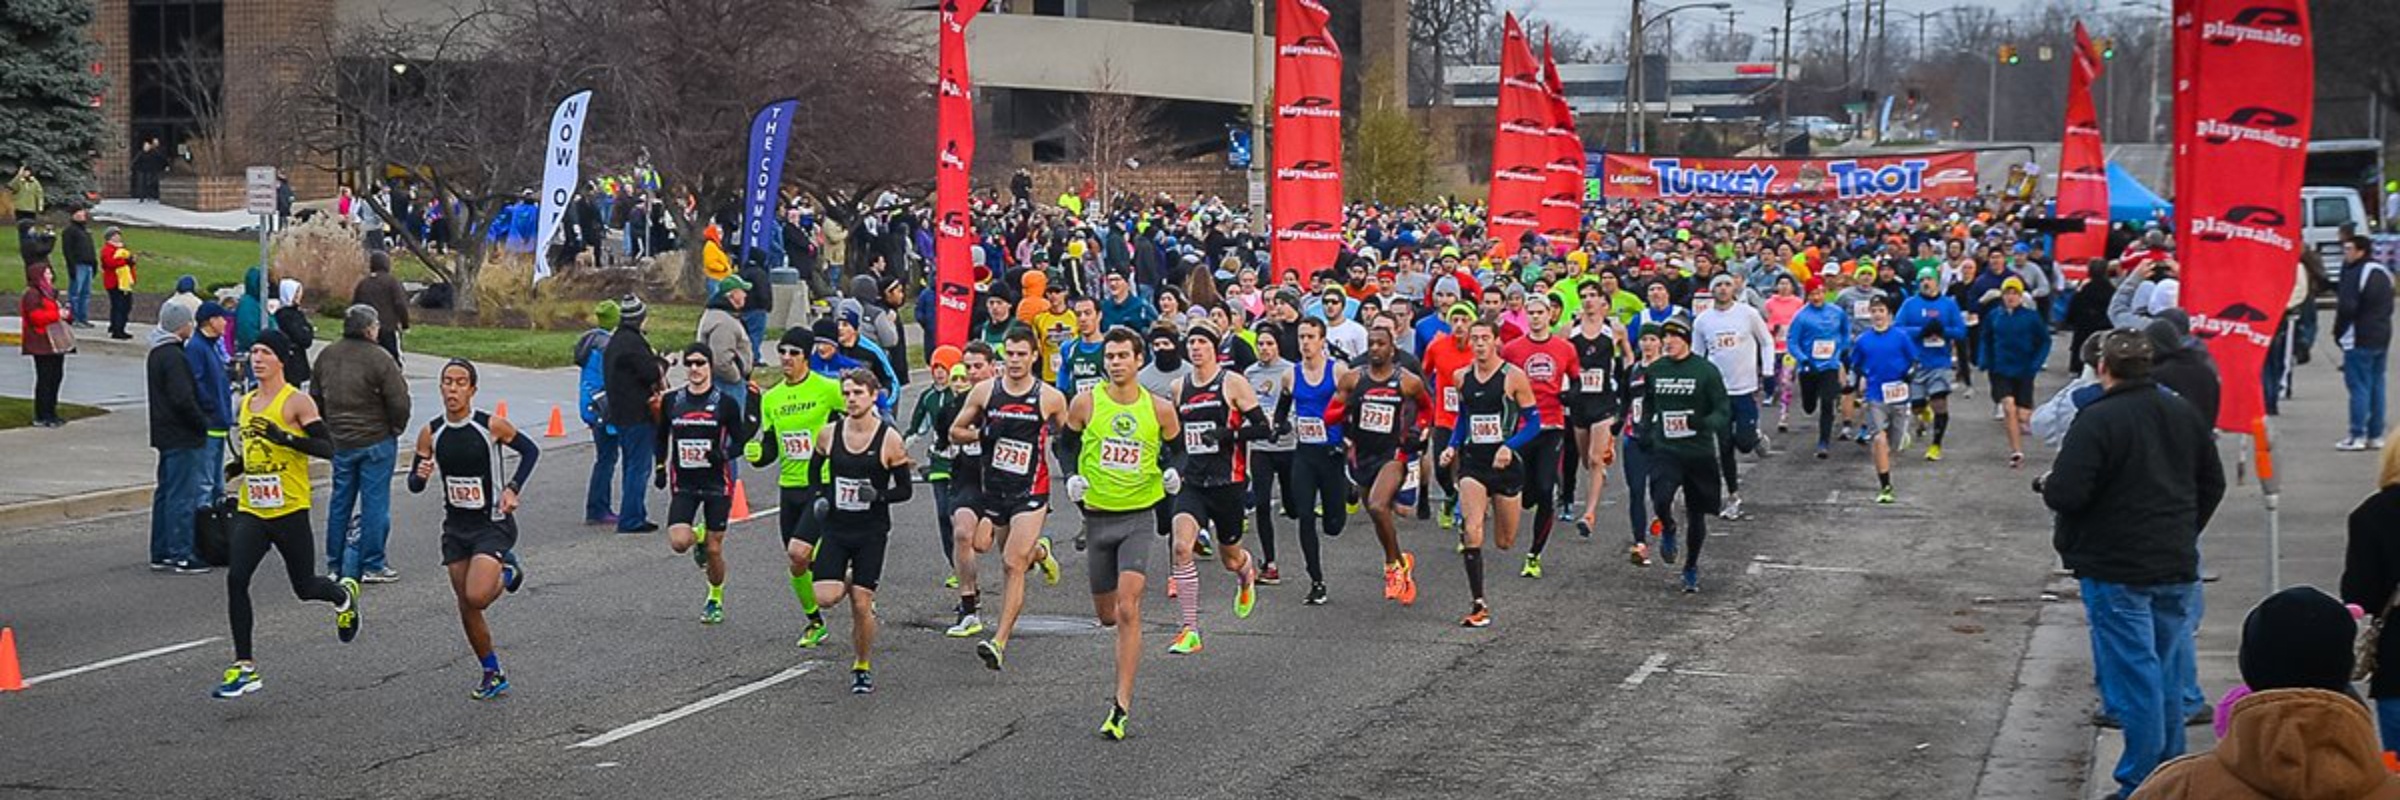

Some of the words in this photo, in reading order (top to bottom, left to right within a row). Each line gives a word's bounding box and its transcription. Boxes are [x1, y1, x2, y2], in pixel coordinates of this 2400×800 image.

[555, 100, 578, 168] NOW
[765, 107, 782, 151] THE
[1649, 157, 1779, 199] TURKEY
[1828, 158, 1930, 200] TROT
[1362, 409, 1392, 426] 2739
[995, 444, 1029, 467] 2738
[1102, 444, 1140, 465] 2125
